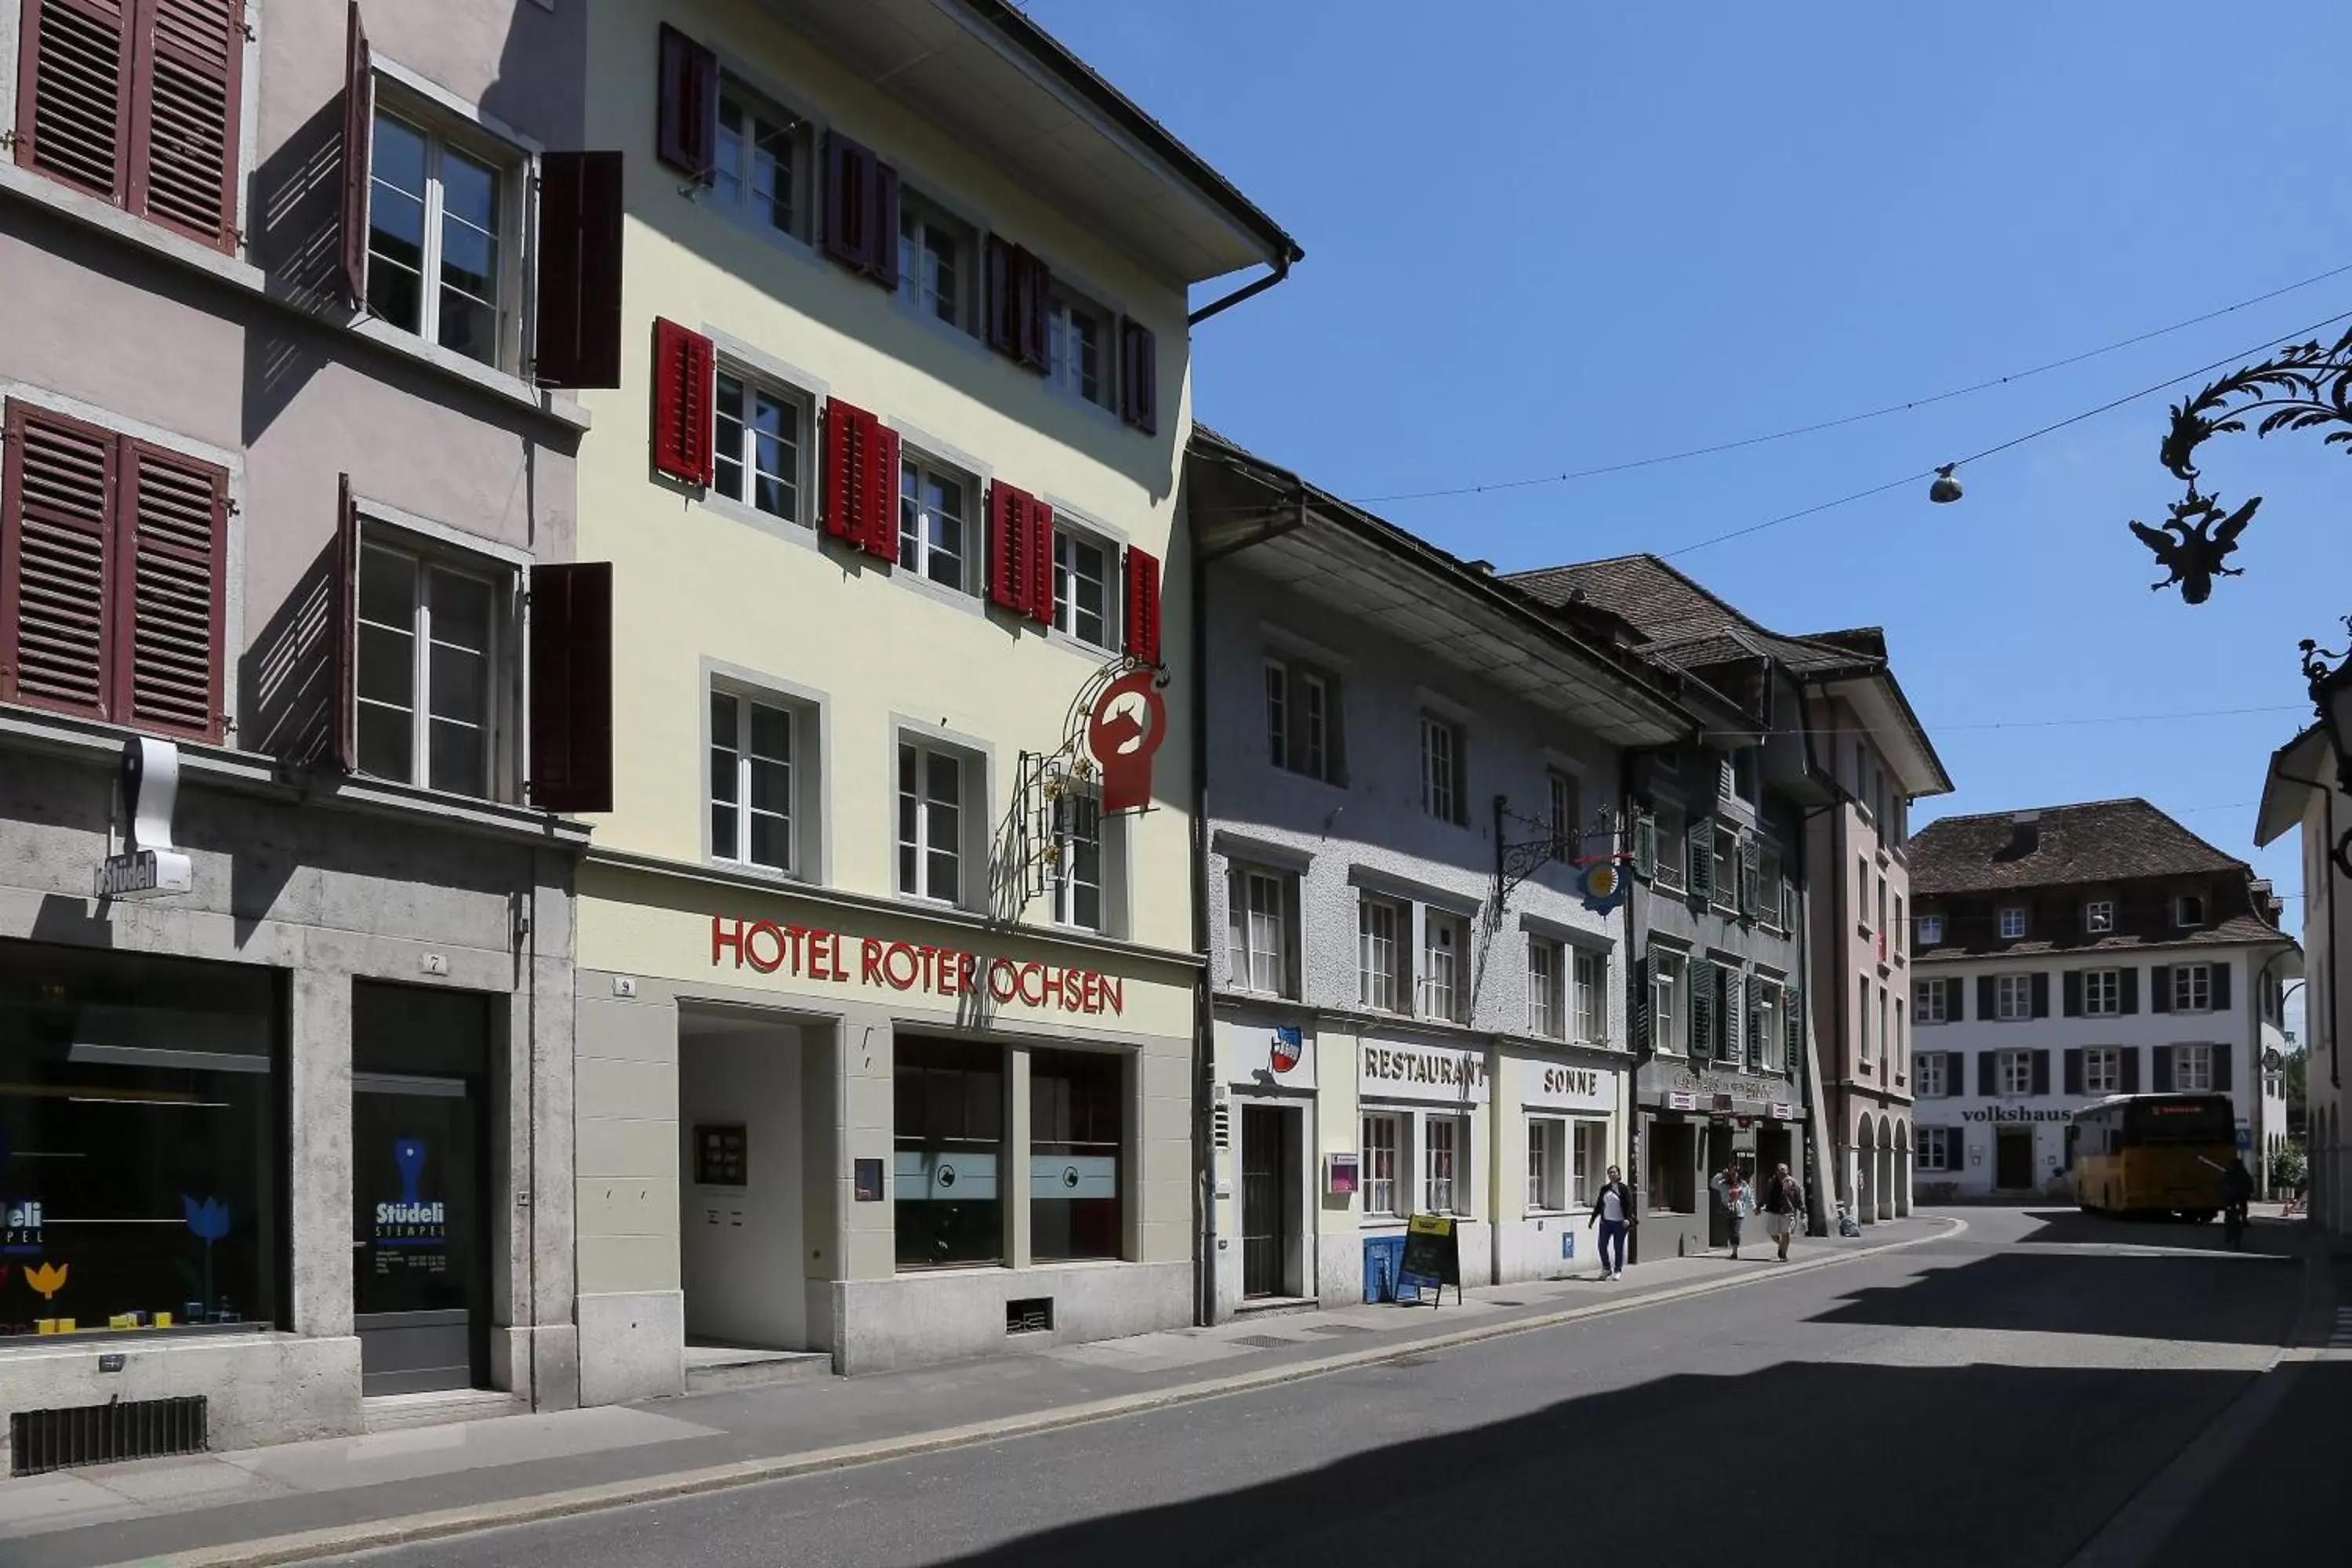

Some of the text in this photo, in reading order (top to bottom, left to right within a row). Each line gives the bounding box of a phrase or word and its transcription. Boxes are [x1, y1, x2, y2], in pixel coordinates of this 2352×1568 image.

[105, 851, 155, 894] Stüdeli
[431, 955, 439, 970] 7
[712, 914, 1122, 1017] HOTEL ROTER OCHSEN
[622, 980, 630, 993] 9
[1365, 1047, 1486, 1087] RESTAURANT
[1544, 1068, 1597, 1096] SONNE
[1962, 1105, 2072, 1122] volkshaus
[376, 1202, 444, 1224] Stüdeli
